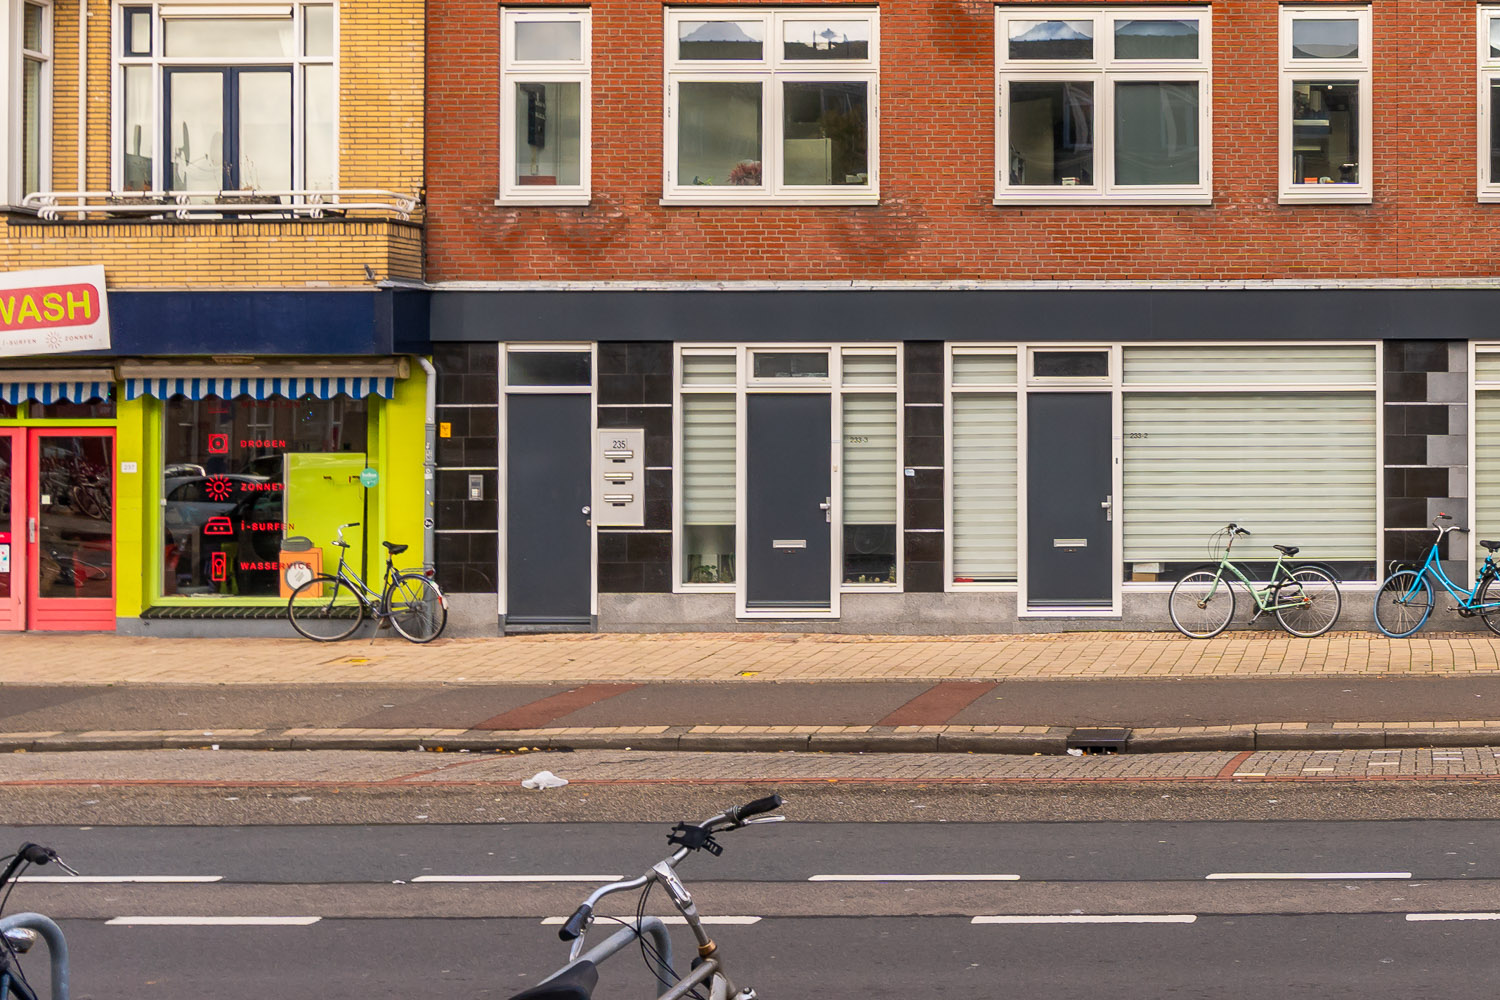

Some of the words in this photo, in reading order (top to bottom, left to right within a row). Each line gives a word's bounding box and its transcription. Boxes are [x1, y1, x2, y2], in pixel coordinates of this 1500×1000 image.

[240, 440, 286, 448] DROGEN
[849, 436, 869, 444] 233-3
[612, 440, 626, 449] 235
[240, 483, 285, 491] ZONNEN
[240, 562, 312, 570] WASSERVICE
